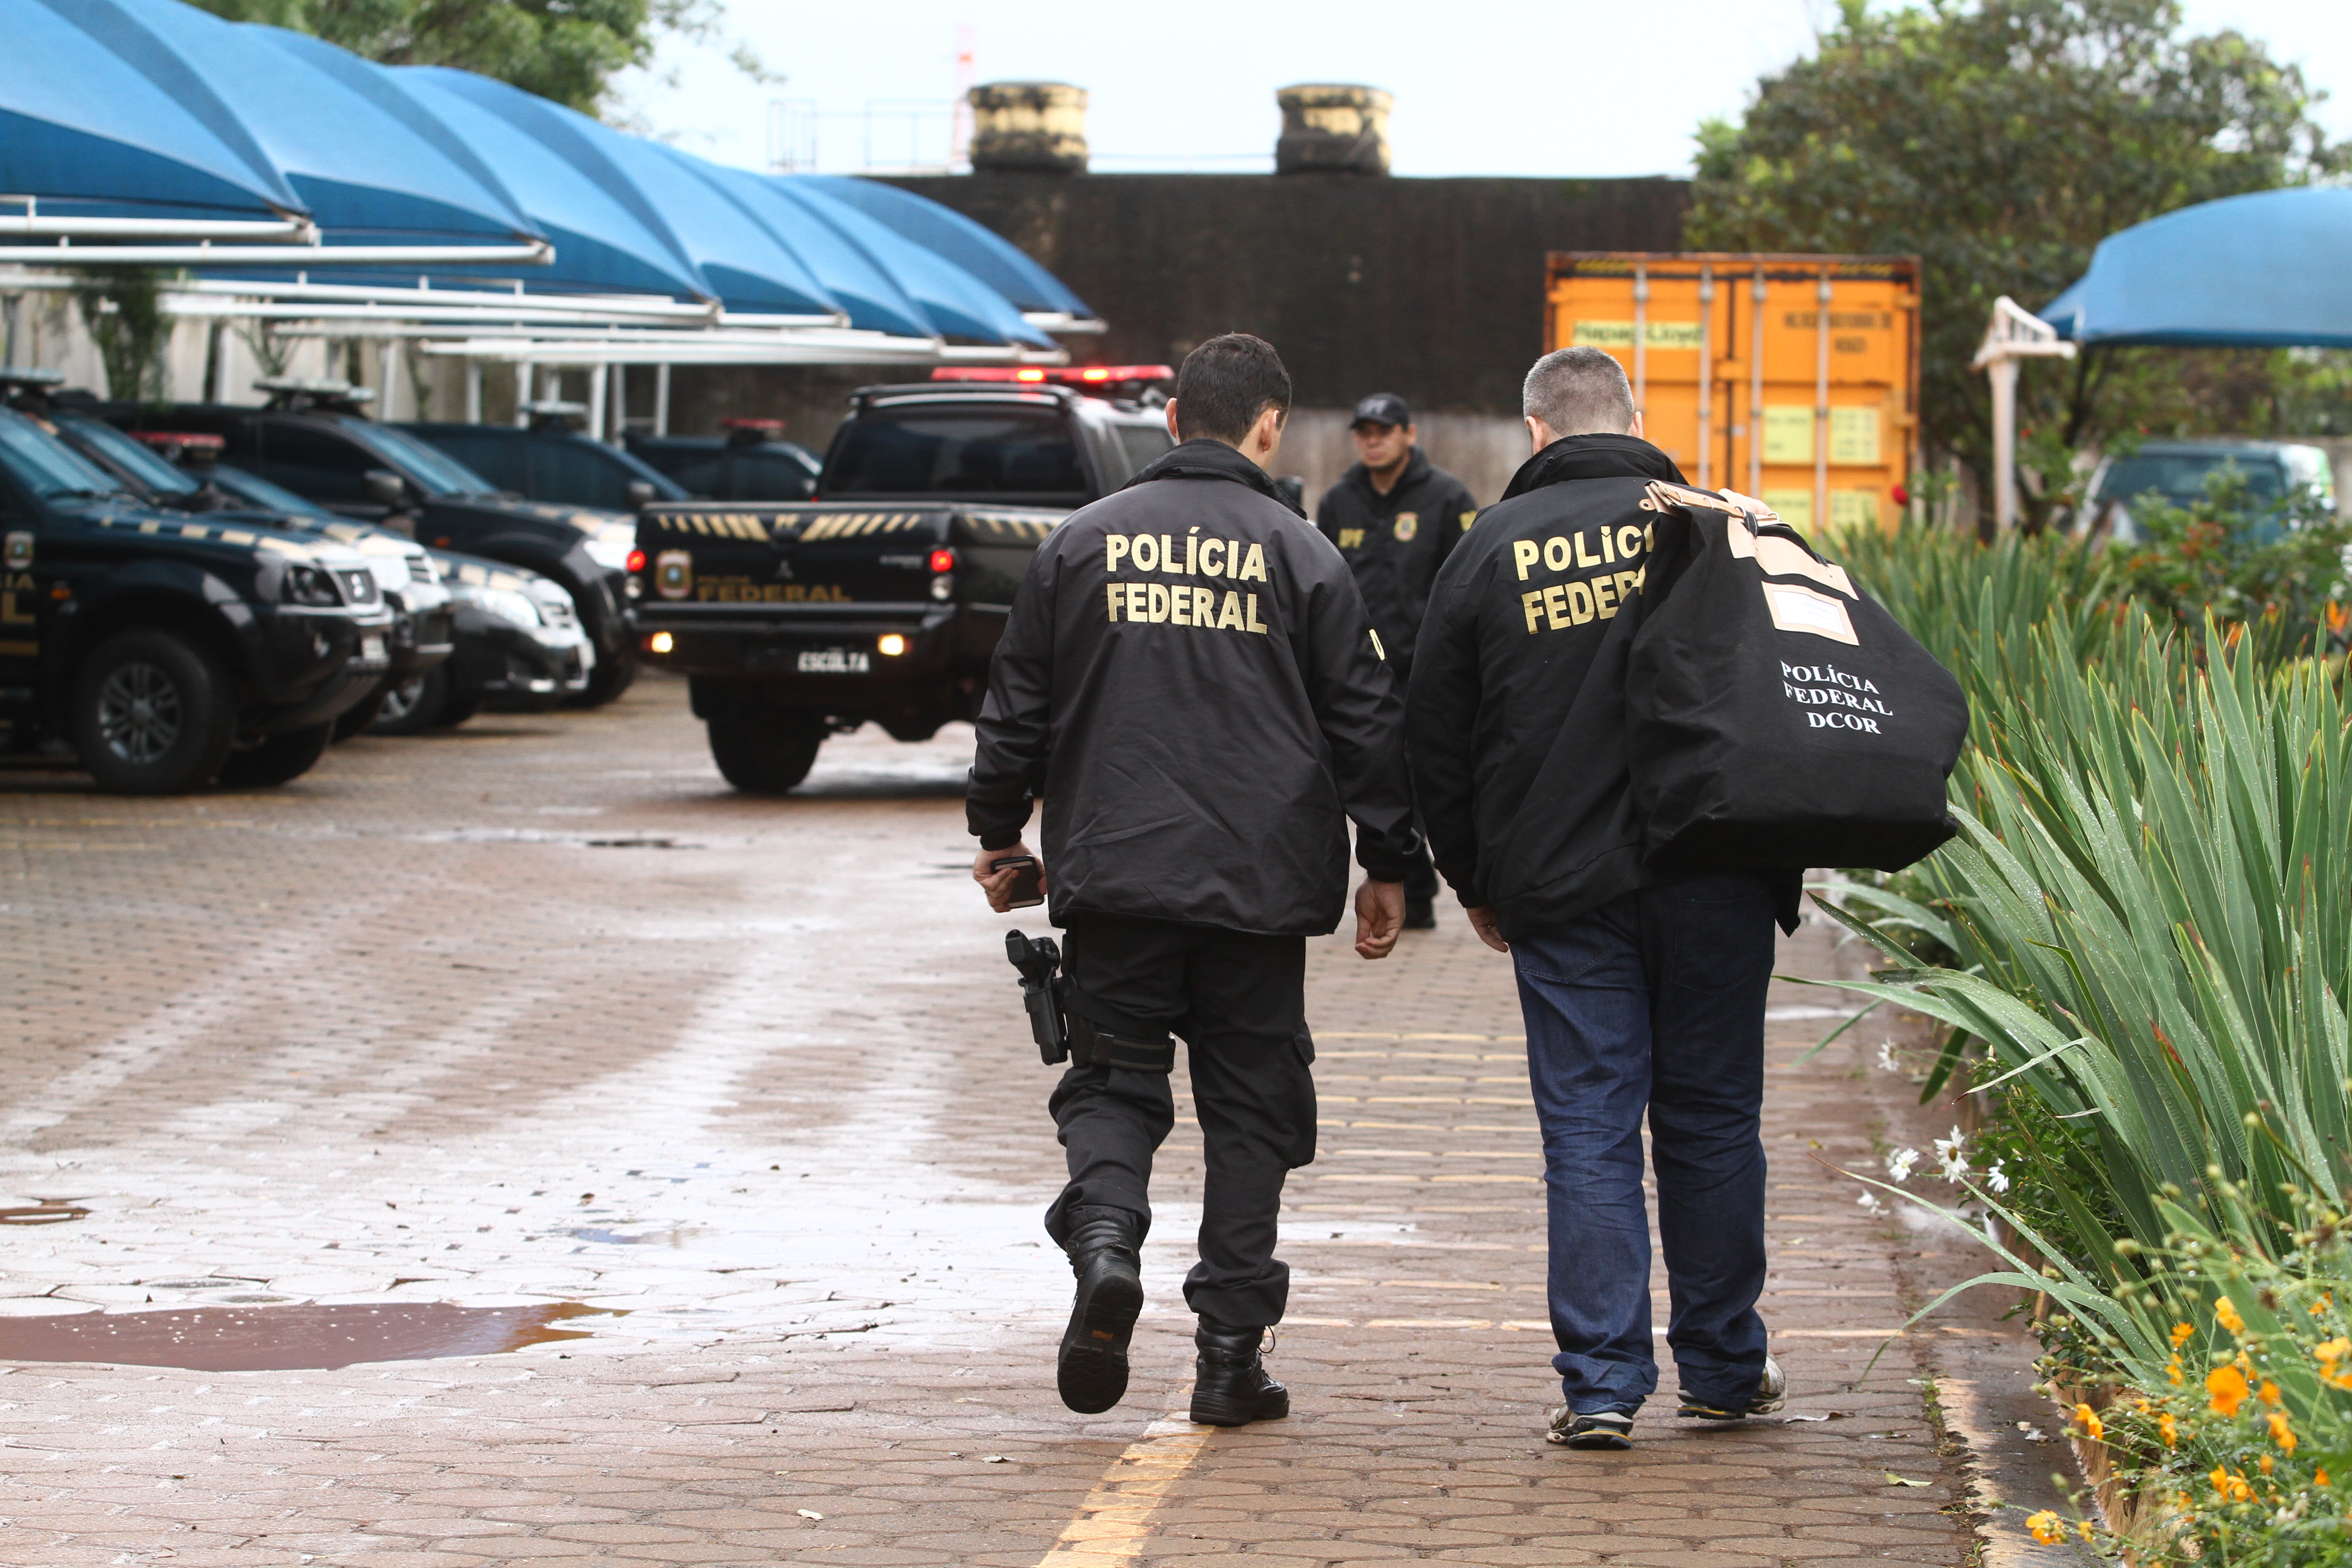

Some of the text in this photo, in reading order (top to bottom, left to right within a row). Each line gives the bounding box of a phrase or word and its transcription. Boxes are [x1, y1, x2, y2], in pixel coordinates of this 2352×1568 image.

[1106, 526, 1267, 582] POLÍCIA
[698, 585, 853, 602] FEDERAL
[1107, 583, 1267, 634] FEDERAL
[1780, 660, 1880, 695] POLÍCIA
[1782, 680, 1893, 716] FEDERAL
[1805, 712, 1882, 735] DCOR
